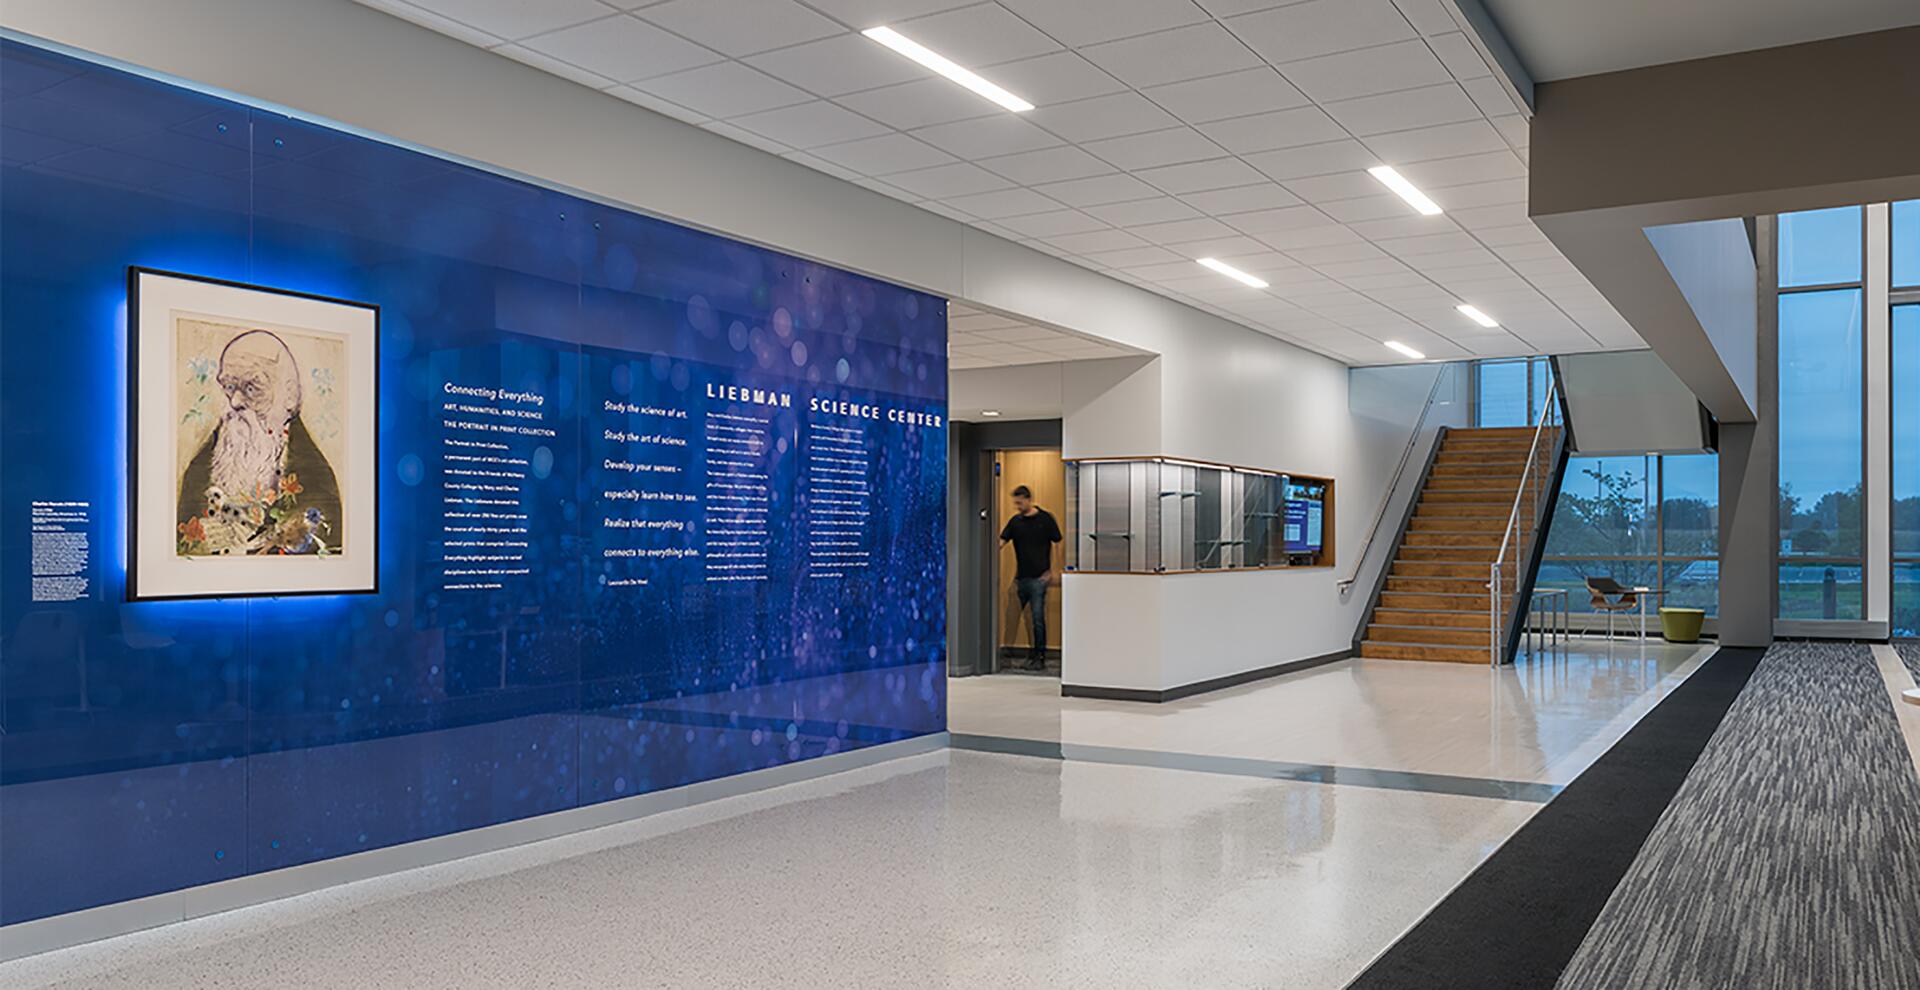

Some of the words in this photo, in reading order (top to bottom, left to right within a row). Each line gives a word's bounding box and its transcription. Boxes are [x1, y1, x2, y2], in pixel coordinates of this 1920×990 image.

[444, 382, 496, 400] Connecting
[499, 389, 544, 406] Everything
[605, 400, 626, 413] Study
[627, 403, 639, 413] the
[641, 406, 666, 416] science
[668, 409, 676, 417] of
[707, 383, 791, 408] LIEBMAN
[810, 398, 879, 419] SCIENCE
[888, 409, 942, 428] CENTER
[444, 420, 456, 428] THE
[458, 422, 489, 430] PORTRAIT
[518, 427, 556, 437] COLLECTION
[604, 429, 626, 443] Study
[627, 432, 639, 442] the
[641, 435, 651, 443] art
[652, 435, 661, 443] of
[604, 459, 635, 472] Develop
[636, 464, 651, 472] your
[653, 465, 676, 473] senses
[604, 490, 639, 501] especially
[641, 490, 658, 499] learn
[660, 492, 674, 500] how
[676, 493, 683, 501] to
[604, 518, 630, 527] Realize
[631, 518, 646, 527] that
[648, 520, 684, 531] everything
[604, 549, 636, 557] connects
[648, 548, 683, 558] everything
